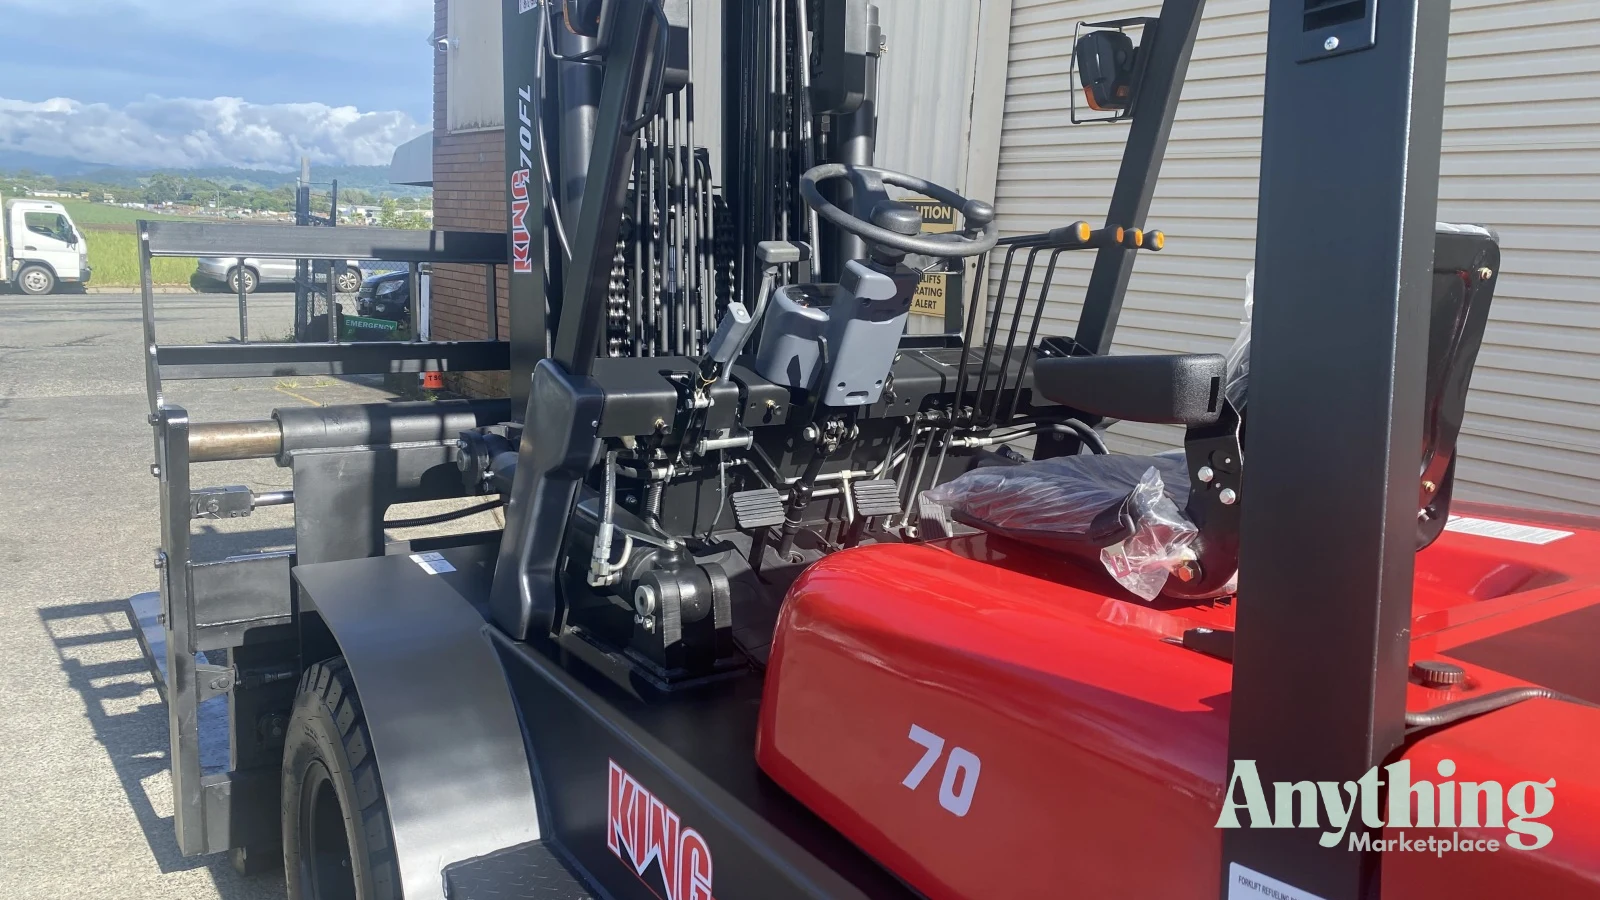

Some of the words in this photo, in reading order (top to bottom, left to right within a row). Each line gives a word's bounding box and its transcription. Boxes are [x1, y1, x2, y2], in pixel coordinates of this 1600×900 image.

[518, 85, 532, 169] 70FL
[512, 168, 532, 272] KING
[916, 205, 951, 219] UTION
[923, 275, 941, 284] LIFTS
[914, 286, 942, 297] RATING
[915, 299, 937, 309] ALERT
[345, 319, 394, 331] EMERGENCY
[902, 723, 981, 817] 70
[607, 758, 712, 900] KING
[1238, 875, 1261, 893] FORKLIFT
